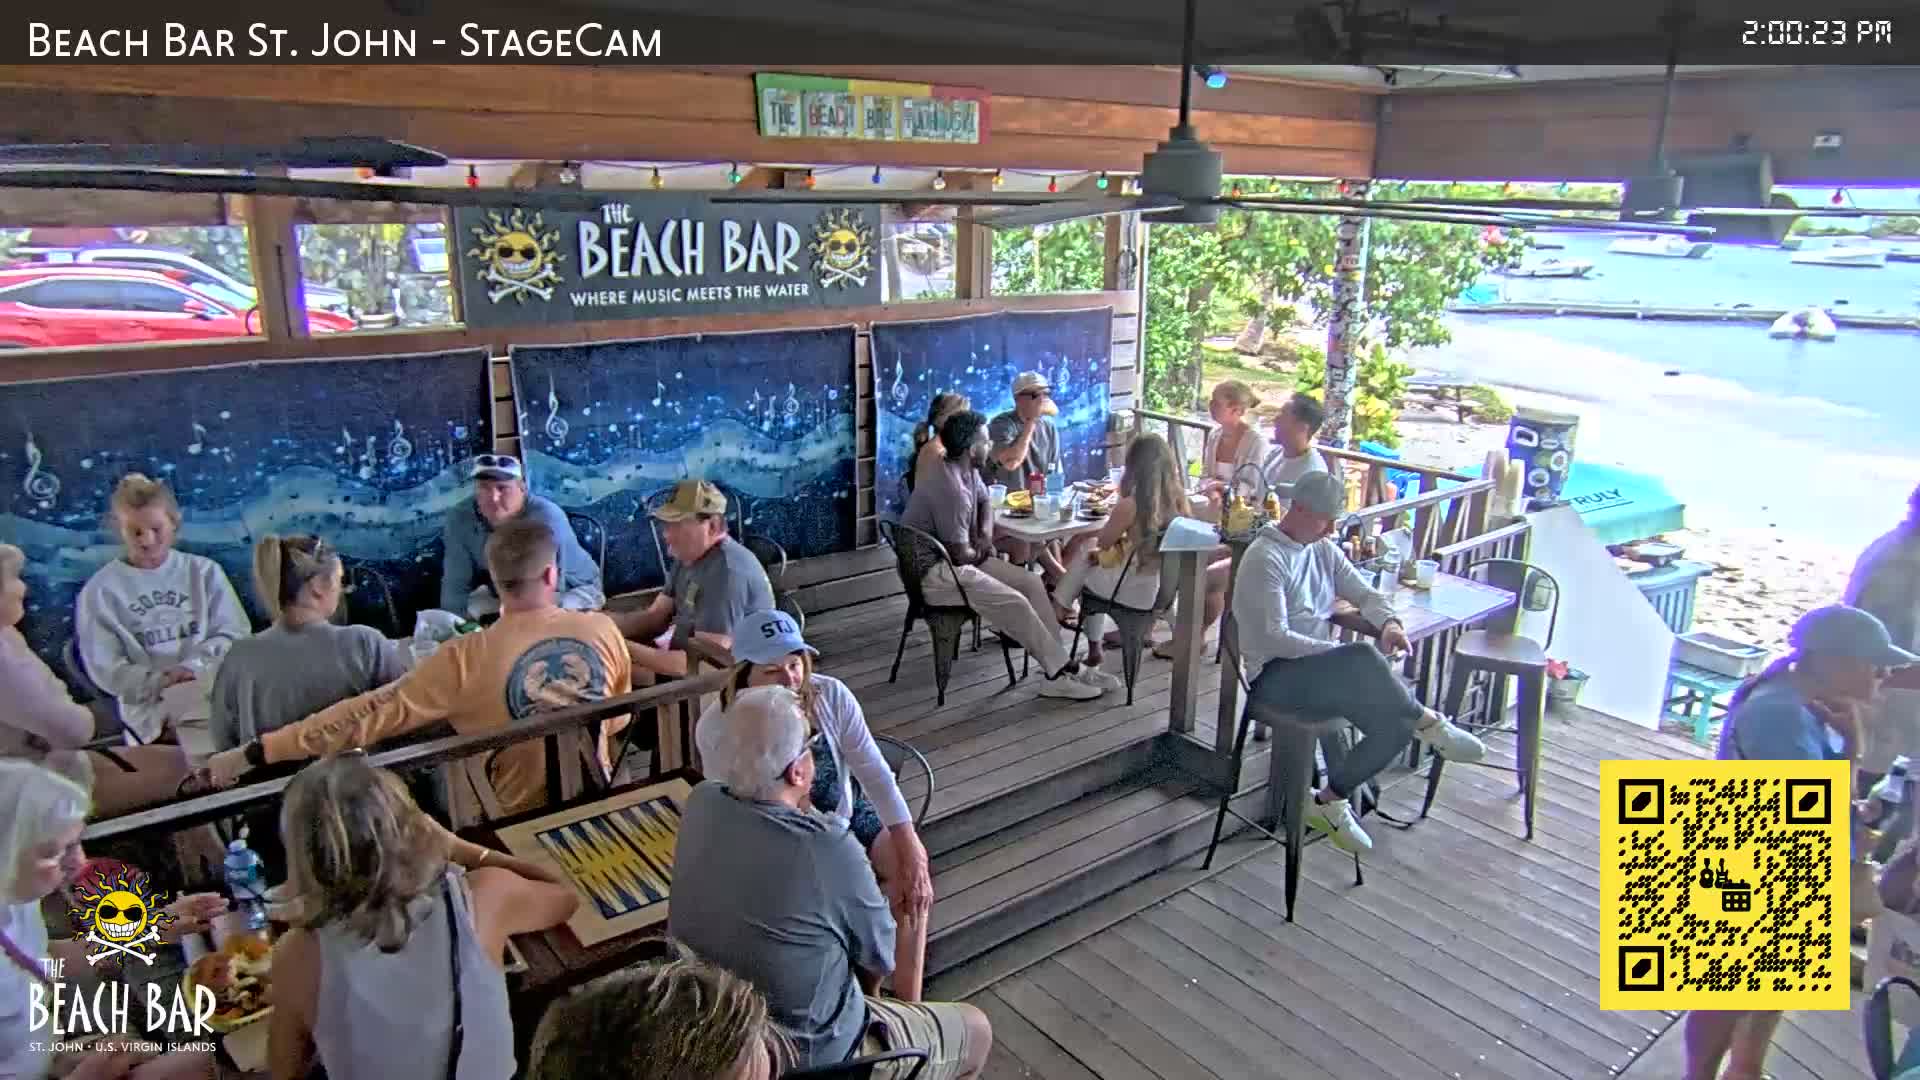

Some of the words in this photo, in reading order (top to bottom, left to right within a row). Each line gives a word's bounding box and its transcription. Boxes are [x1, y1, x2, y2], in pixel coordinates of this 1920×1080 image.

[601, 203, 632, 224] THE
[577, 219, 706, 279] BEACH
[722, 218, 802, 275] BAR
[570, 290, 627, 307] WHERE
[632, 288, 681, 304] MUSIC
[686, 286, 733, 302] MEETS
[736, 284, 761, 299] THE
[764, 282, 810, 298] WATER
[128, 590, 189, 616] SOGGY
[760, 619, 795, 639] STJ
